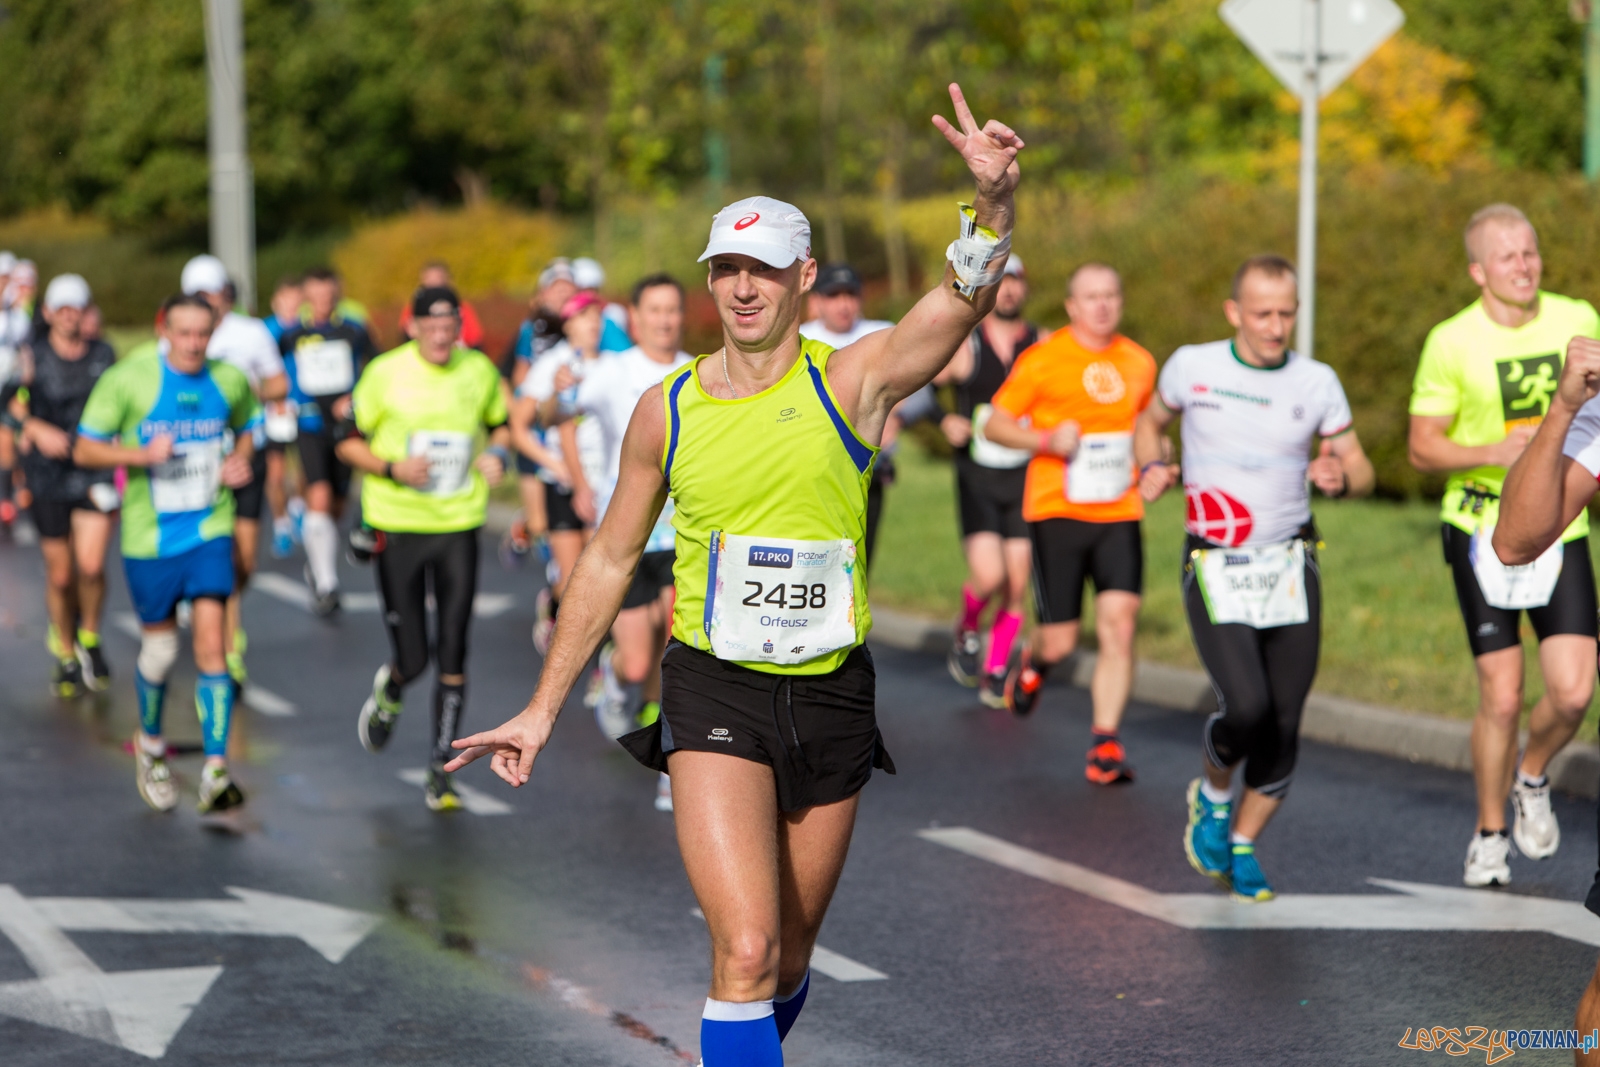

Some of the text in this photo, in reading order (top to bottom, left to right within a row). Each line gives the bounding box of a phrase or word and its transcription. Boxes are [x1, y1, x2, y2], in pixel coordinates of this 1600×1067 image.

[753, 551, 790, 563] 17. PKO
[742, 580, 826, 610] 2438
[760, 615, 808, 628] Orfeusz
[790, 646, 805, 654] 4F
[707, 734, 733, 743] Kalenji
